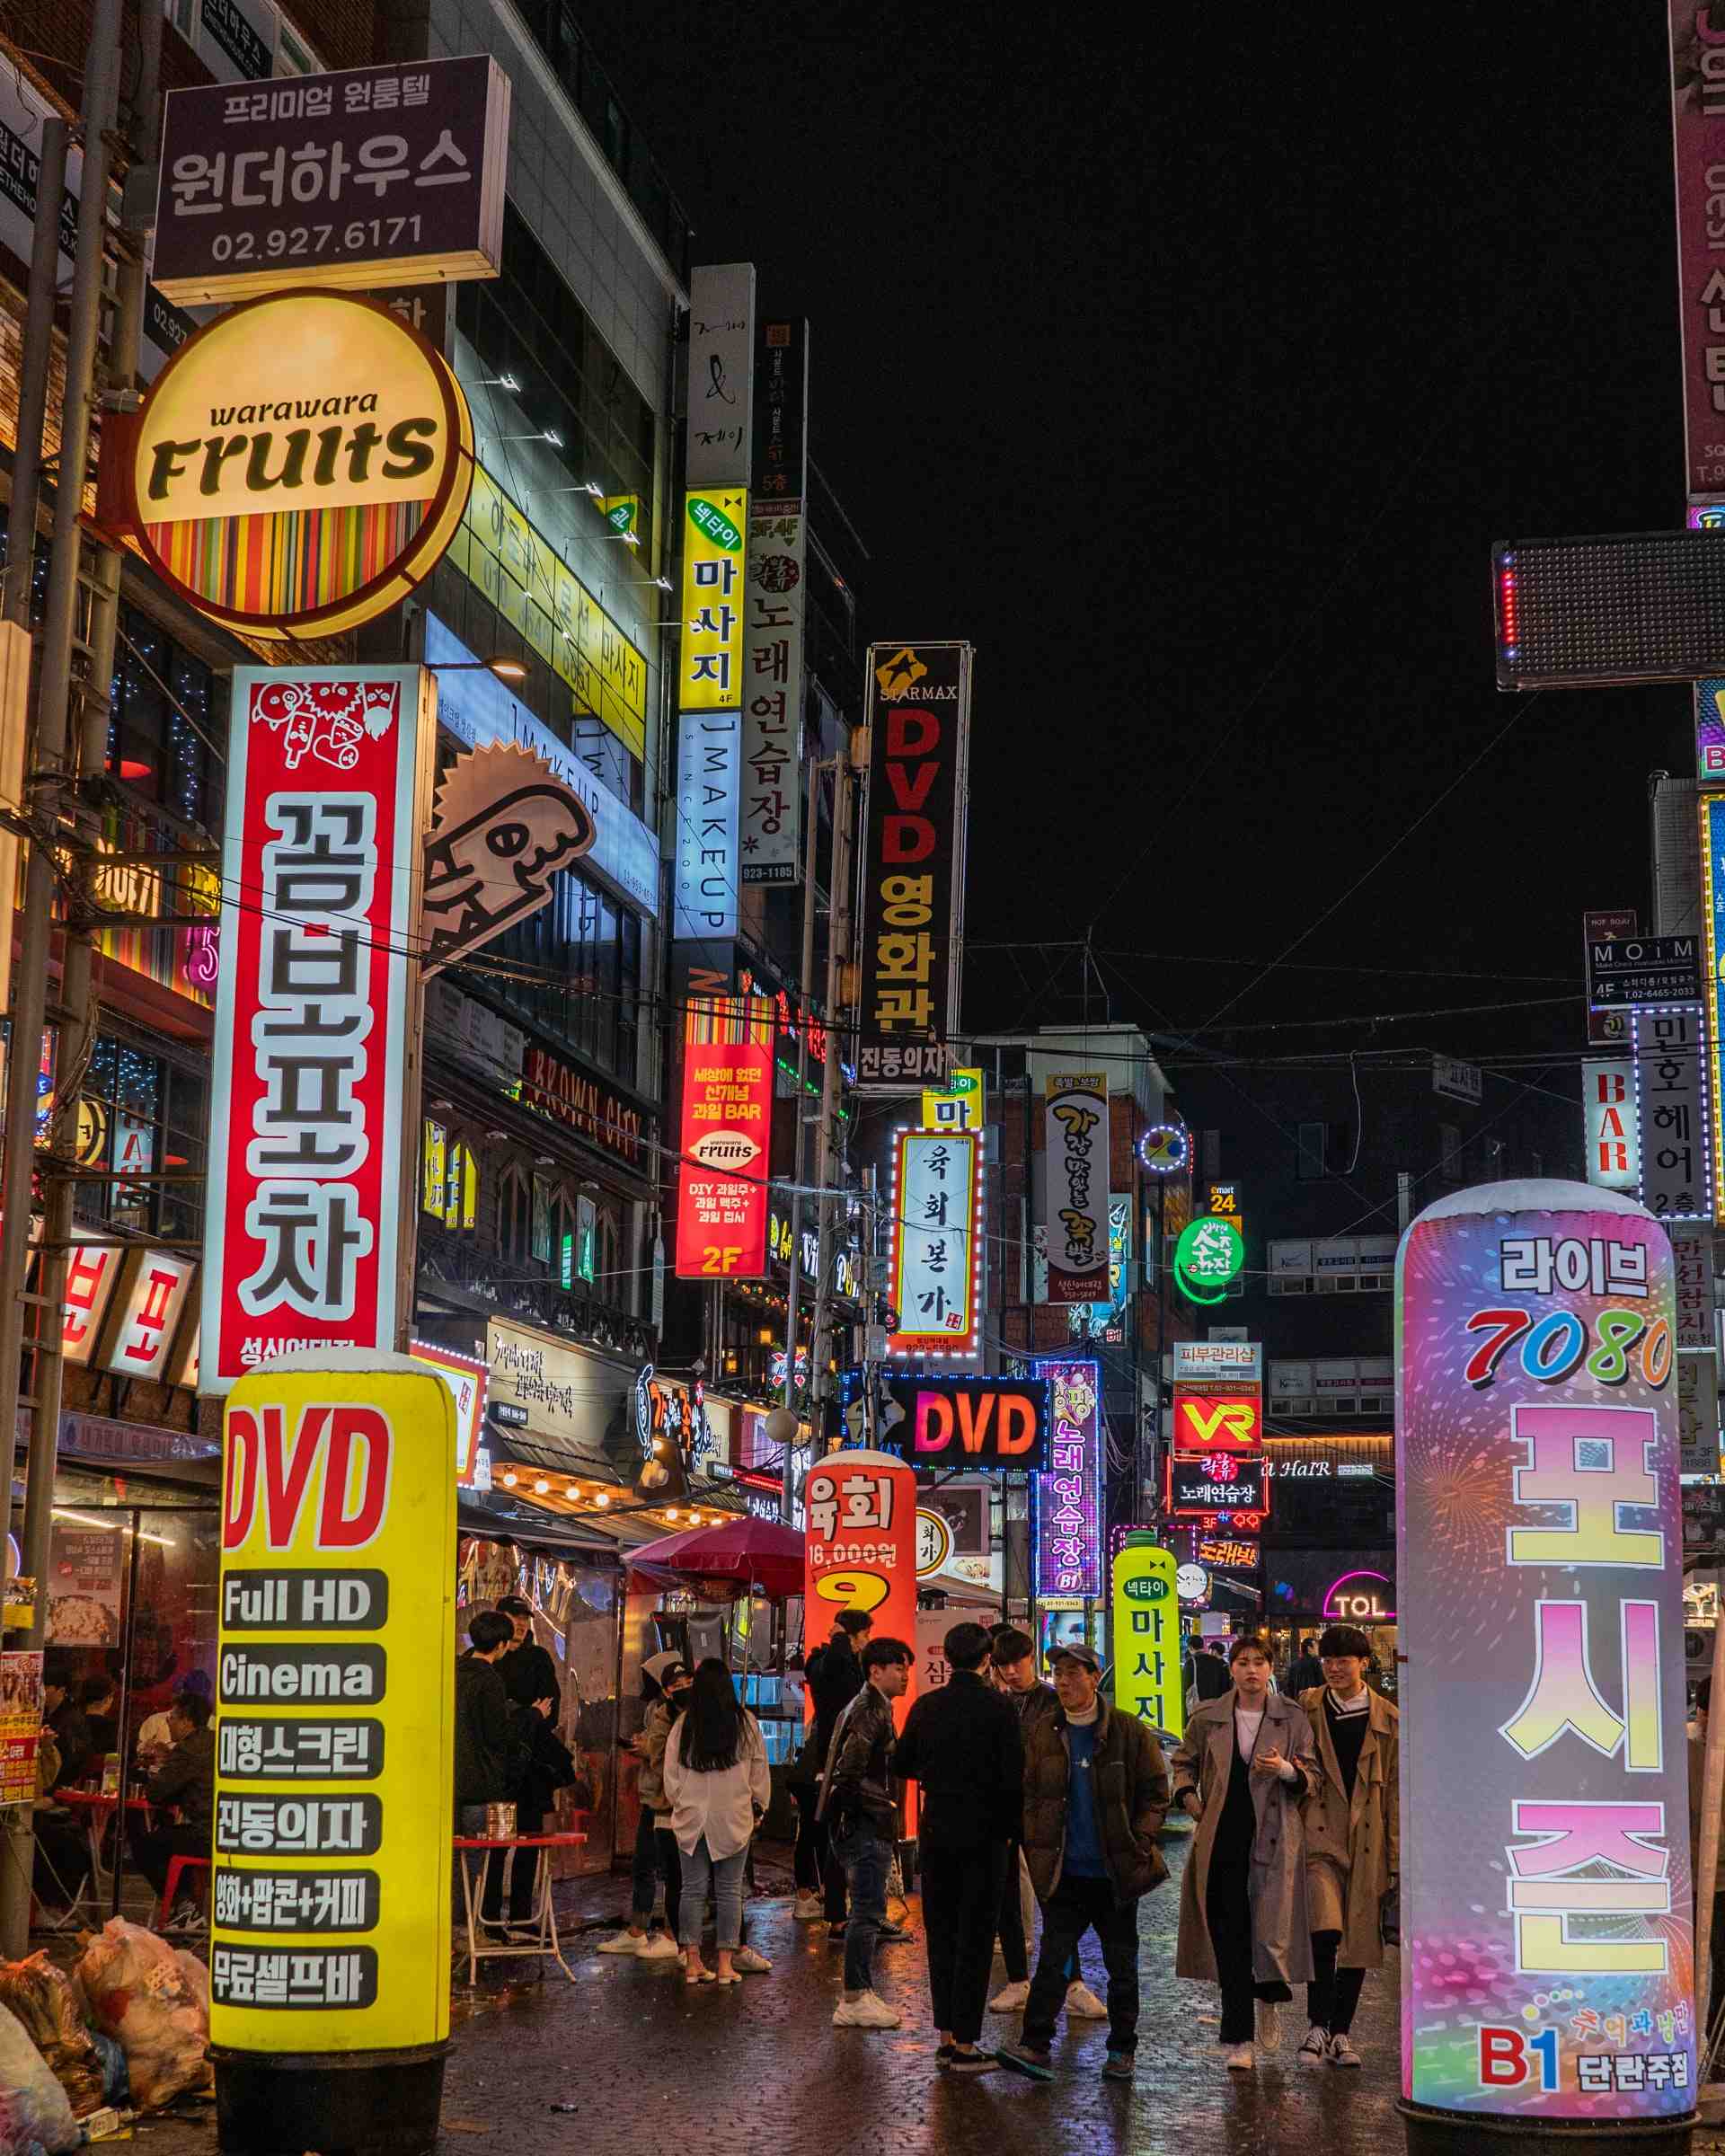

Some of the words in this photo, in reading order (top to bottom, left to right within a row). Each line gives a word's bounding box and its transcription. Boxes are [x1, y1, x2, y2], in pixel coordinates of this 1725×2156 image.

[223, 85, 332, 124] 프리미엄
[344, 73, 430, 112] 원룸텔
[171, 128, 472, 216] 원더하우스
[211, 215, 422, 263] 02.927.6171
[209, 393, 378, 427] warawara
[147, 418, 438, 501] Fruits
[694, 502, 739, 549] 넥타이
[690, 558, 737, 690] 마사지
[719, 694, 734, 703] 4F
[748, 598, 794, 835] 노래연습장
[880, 686, 958, 701] STARMAX
[682, 733, 695, 824] SINCE
[881, 709, 941, 862] DVD
[875, 875, 935, 1032] 영화관
[250, 802, 366, 1307] 꼼보포차
[694, 1067, 732, 1082] 세상에
[692, 1104, 721, 1119] 과일
[725, 1104, 762, 1120] BAR
[705, 1084, 749, 1101] 신개념
[1652, 1016, 1690, 1182] 민호헤어
[1595, 1073, 1628, 1172] BAR
[698, 1145, 753, 1158] Fruits
[689, 1184, 713, 1196] DIY
[1210, 1195, 1236, 1213] 24
[1655, 1192, 1695, 1212] 2층
[702, 1246, 742, 1272] 2F
[1500, 1237, 1650, 1298] 라이브
[1464, 1308, 1673, 1388] 7080
[915, 1391, 1037, 1454] DVD
[1182, 1402, 1255, 1442] VR
[224, 1405, 392, 1550] DVD
[1052, 1419, 1085, 1568] 노래연습장
[1181, 1485, 1256, 1504] 노래연습장
[810, 1474, 893, 1542] 육회
[225, 1579, 288, 1622] Full
[301, 1579, 371, 1622] HD
[1059, 1574, 1077, 1589] B1
[1127, 1580, 1164, 1597] 넥타이
[222, 1653, 373, 1697] Cinema
[1130, 1608, 1165, 1728] 마사지
[1499, 1404, 1671, 1975] 포시즌
[219, 1725, 369, 1773] 대형스크린
[217, 1874, 367, 1926] 영화+팝콘+커피
[215, 1949, 364, 2004] 무료셀프바
[1478, 2025, 1561, 2092] B1
[1577, 2051, 1689, 2092] 단란주점
